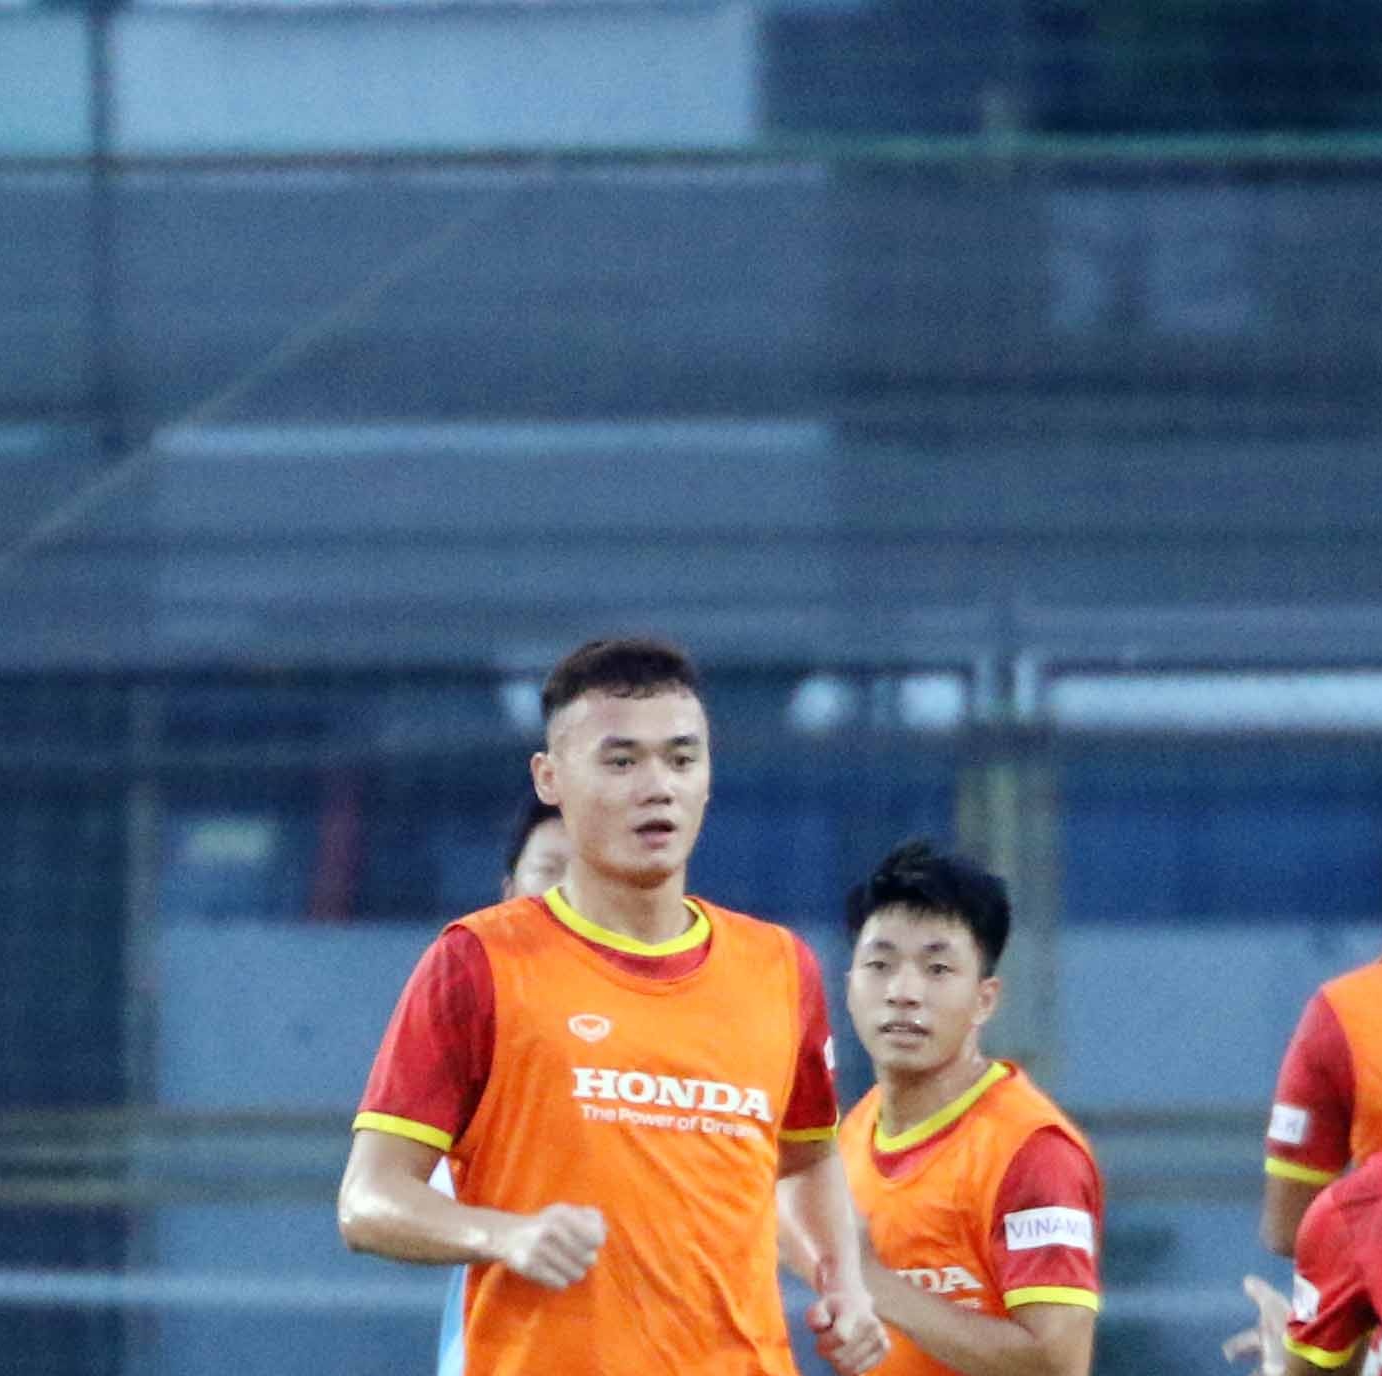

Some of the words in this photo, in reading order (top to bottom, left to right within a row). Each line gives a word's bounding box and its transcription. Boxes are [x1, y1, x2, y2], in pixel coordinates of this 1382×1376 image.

[572, 1067, 773, 1122] HONDA
[581, 1104, 617, 1122] The
[618, 1108, 676, 1128] Power
[677, 1116, 699, 1131] of
